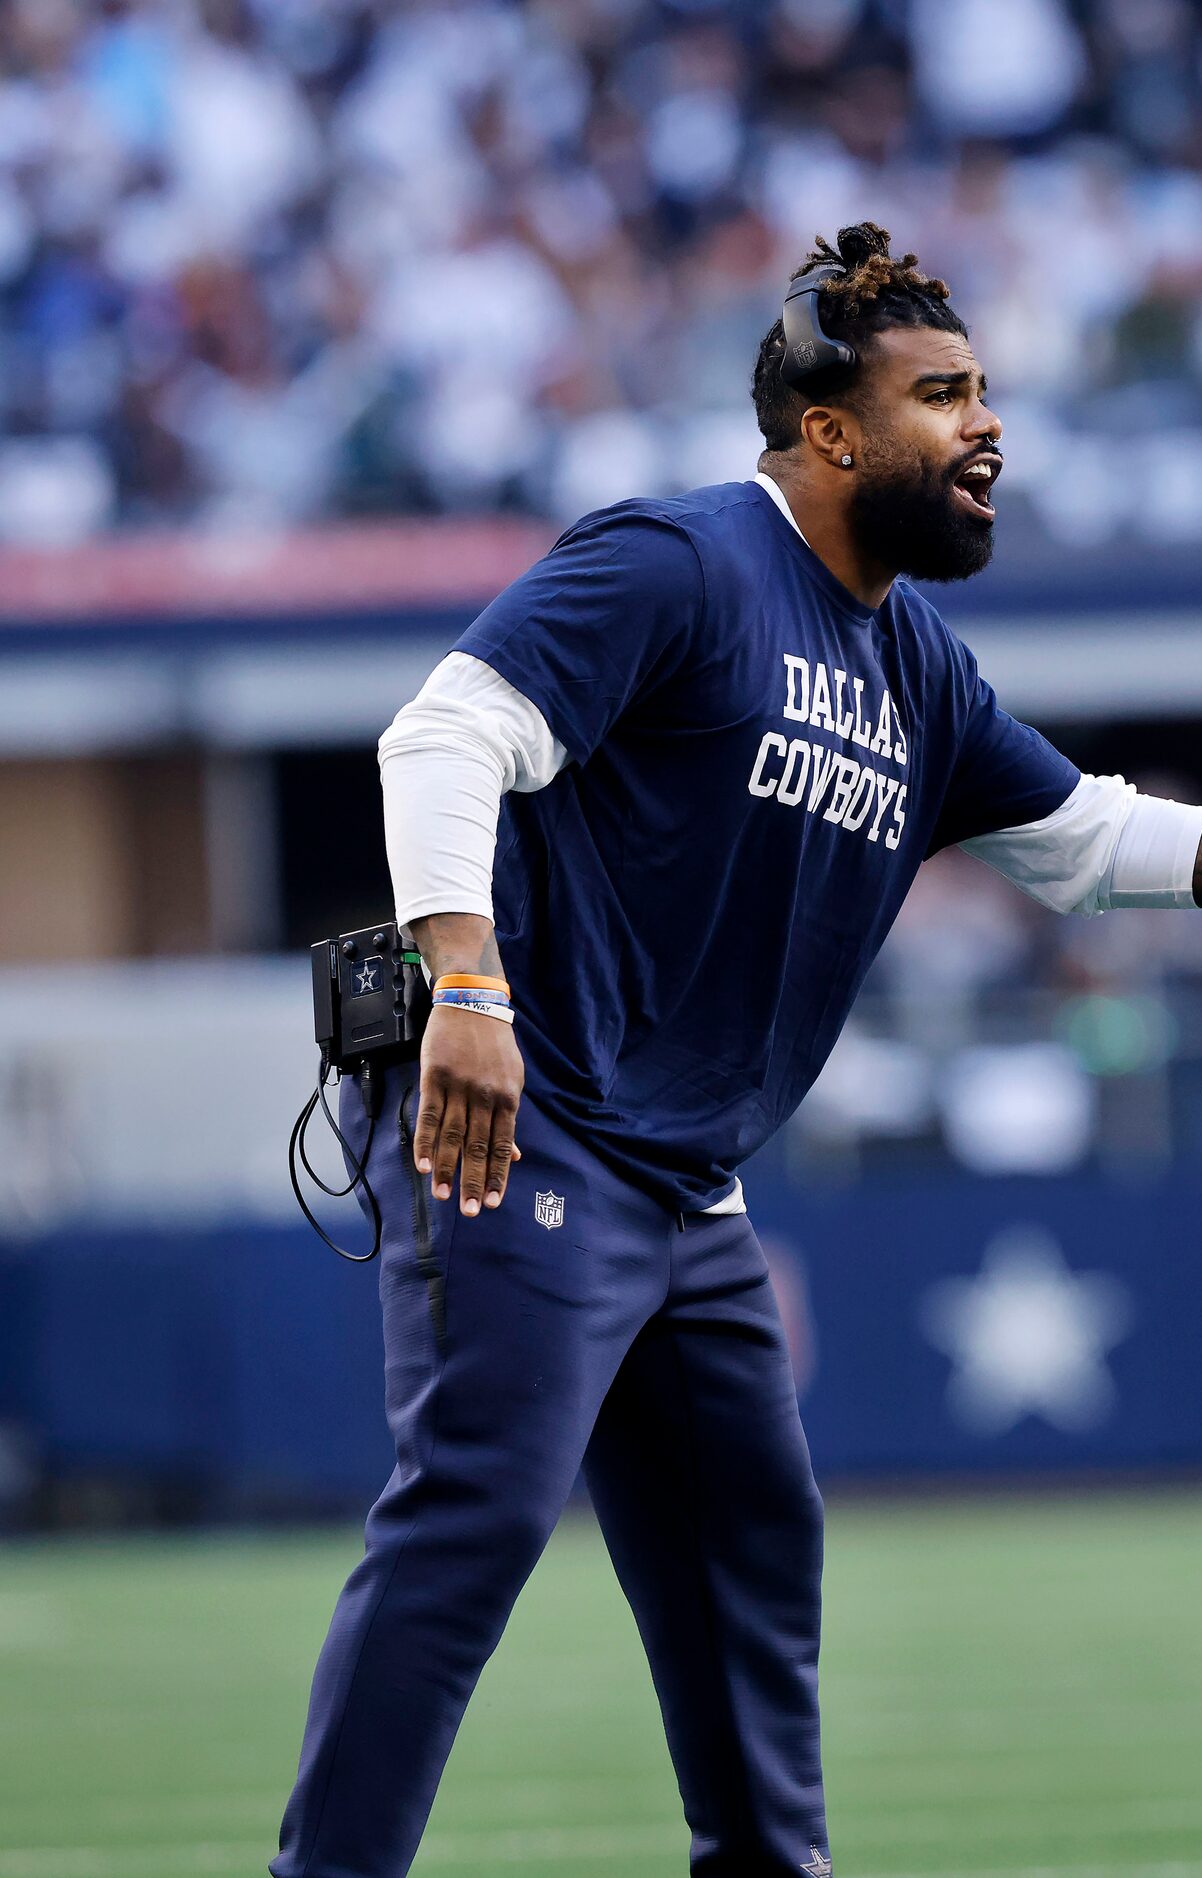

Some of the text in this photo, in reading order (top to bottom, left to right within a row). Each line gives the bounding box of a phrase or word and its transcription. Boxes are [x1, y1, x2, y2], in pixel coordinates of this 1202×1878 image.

[748, 731, 908, 851] COWBOYS
[473, 1002, 491, 1013] WAY
[538, 1205, 561, 1223] NFL
